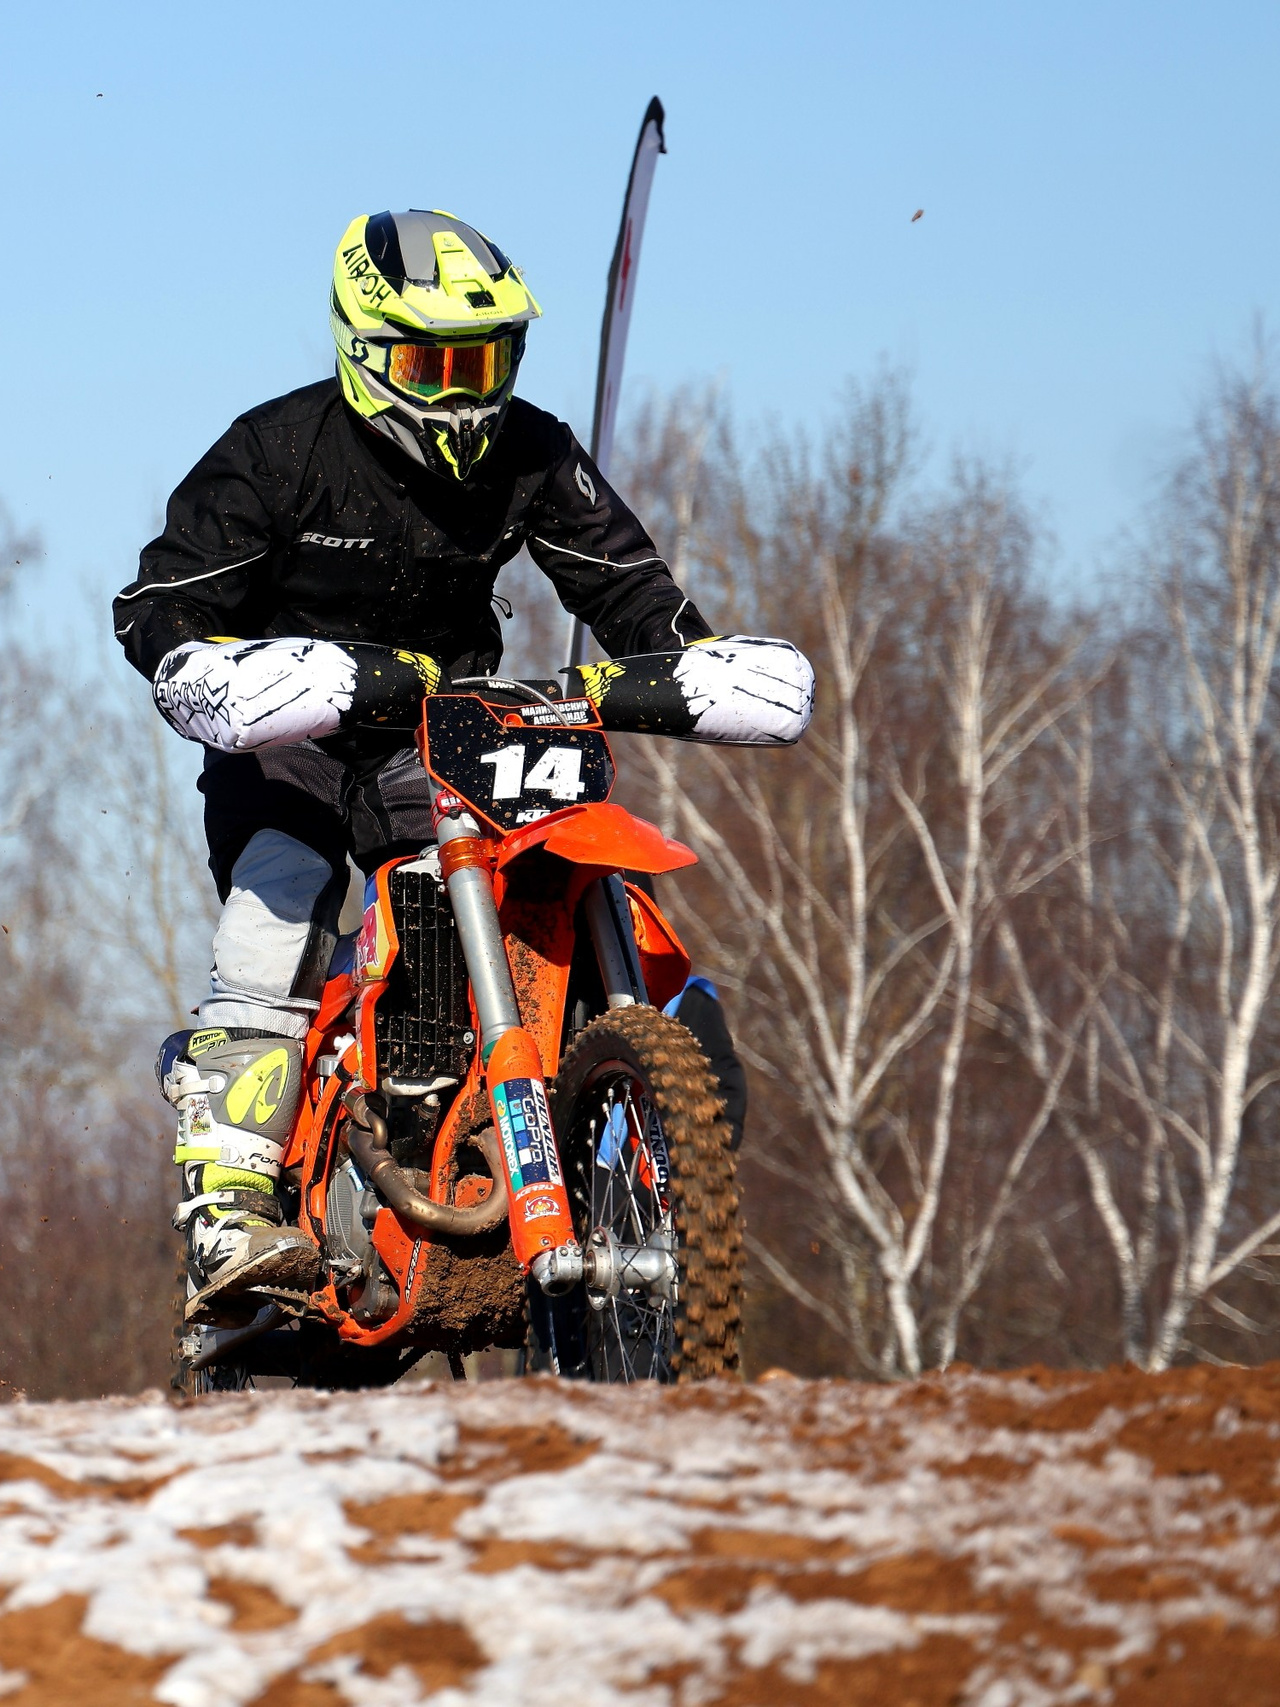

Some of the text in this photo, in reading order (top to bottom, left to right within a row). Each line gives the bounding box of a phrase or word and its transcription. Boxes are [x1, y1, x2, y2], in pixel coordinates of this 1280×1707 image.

[300, 532, 375, 549] SCOTT
[480, 745, 586, 801] 14
[499, 1115, 519, 1178] MOTOREX
[522, 1097, 543, 1163] GoPro
